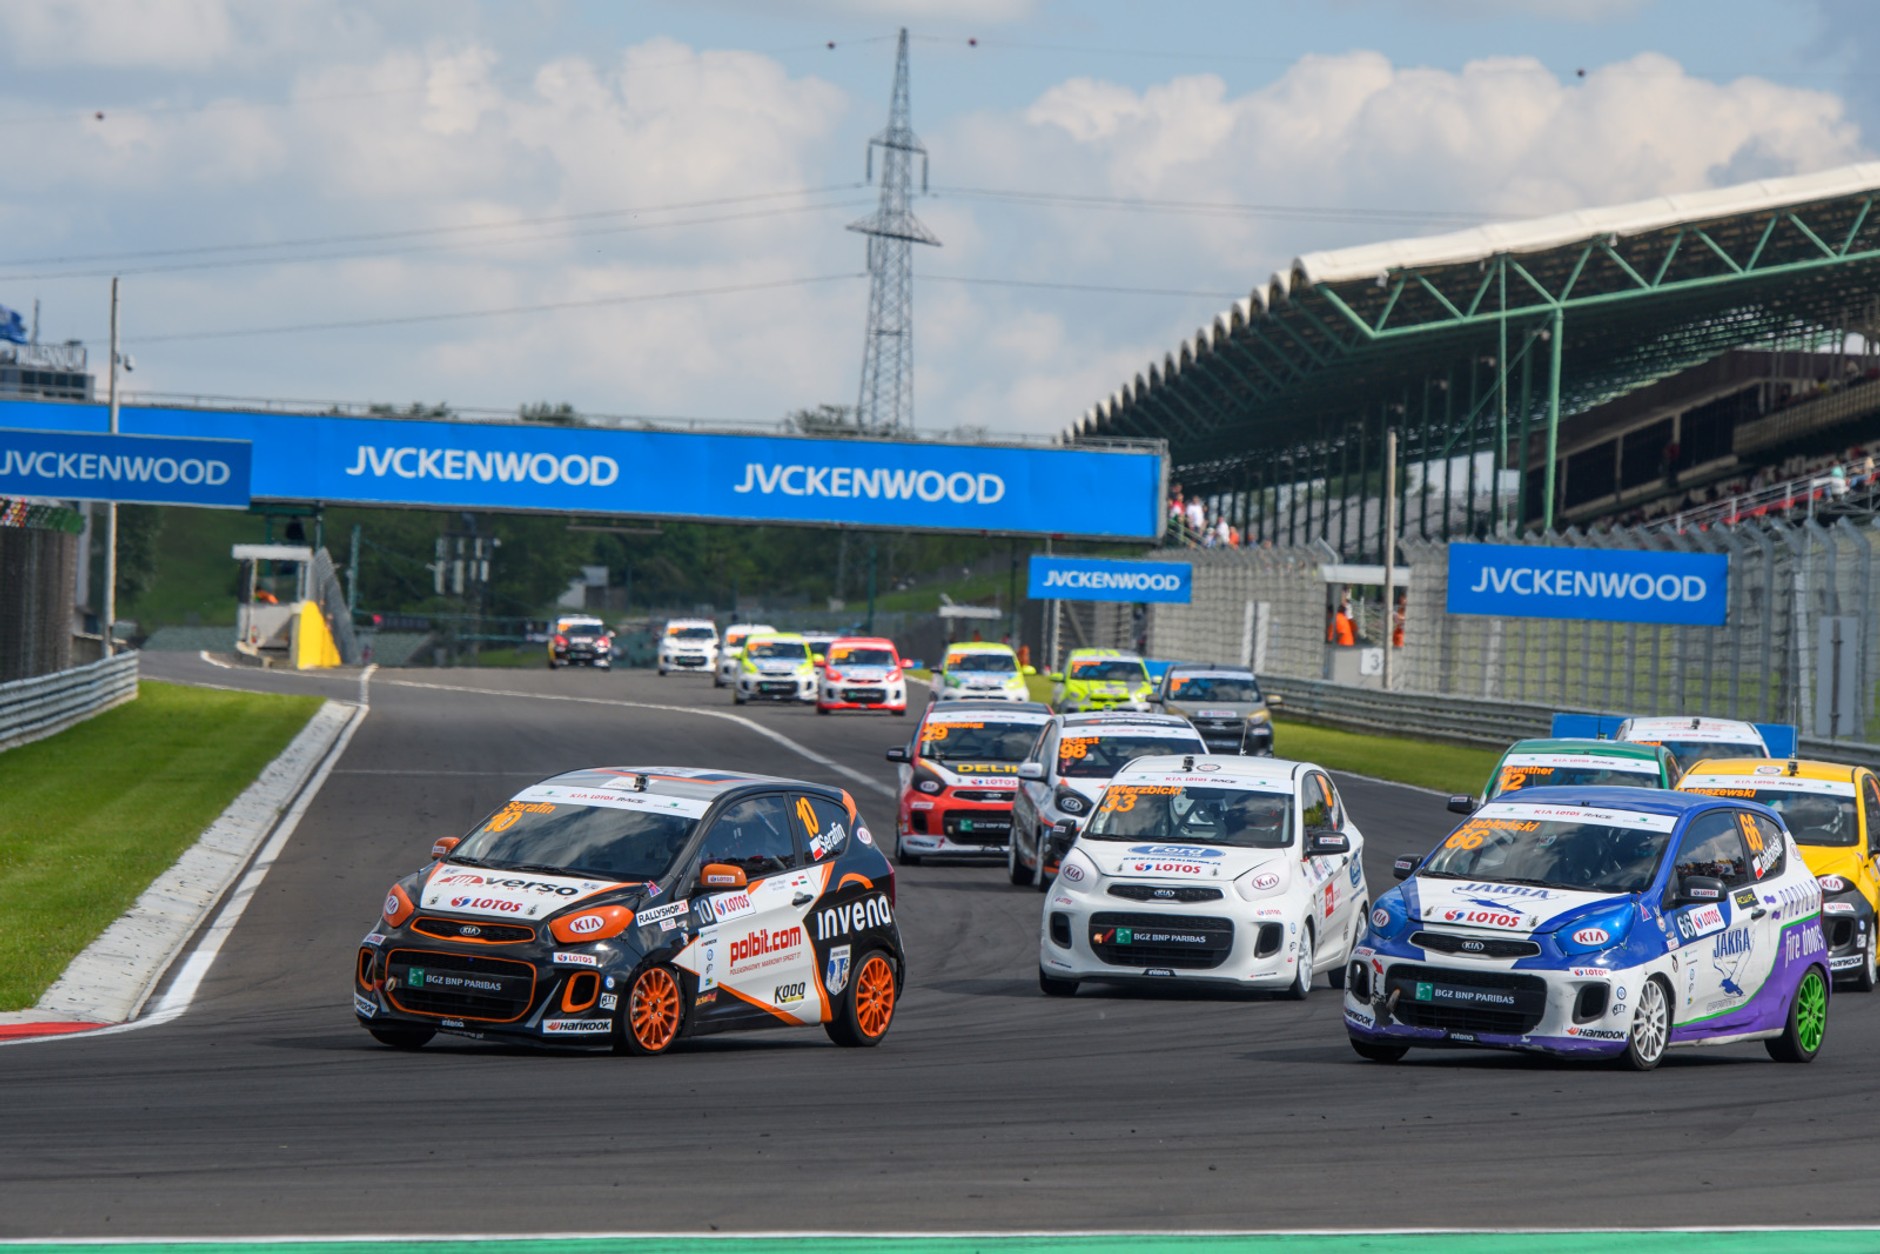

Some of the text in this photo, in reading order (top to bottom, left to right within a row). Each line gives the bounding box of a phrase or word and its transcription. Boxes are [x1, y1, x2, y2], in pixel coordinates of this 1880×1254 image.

[0, 450, 231, 486] JVCKENWOOD
[346, 445, 620, 487] JVCKENWOOD
[734, 463, 1006, 505] JVCKENWOOD
[1043, 569, 1182, 592] JVCKENWOOD
[1471, 566, 1708, 602] JVCKENWOOD
[1369, 652, 1381, 671] 3
[921, 726, 949, 742] 29
[1059, 743, 1088, 759] 98
[985, 778, 1017, 786] LOTOS
[1107, 784, 1184, 796] Wierzbicki
[504, 800, 557, 815] Serafin
[1099, 793, 1138, 813] 33
[484, 810, 524, 833] 10
[795, 796, 820, 838] 10
[1583, 812, 1614, 820] RACE
[816, 821, 847, 854] Serafin
[1443, 828, 1490, 850] 66
[1739, 813, 1764, 851] 66
[1063, 867, 1083, 881] KIA
[1154, 863, 1202, 874] LOTOS
[1457, 883, 1551, 899] JAKRA
[1821, 878, 1841, 889] KIA
[385, 897, 398, 913] KIA
[470, 898, 523, 913] LOTOS
[693, 898, 715, 924] 10
[723, 893, 751, 914] LOTOS
[638, 904, 680, 924] RALLYSHOP
[1373, 910, 1389, 926] KIA
[1466, 911, 1521, 928] LOTOS
[1700, 908, 1722, 927] LOTOS
[573, 916, 601, 932] KIA
[1676, 914, 1697, 940] 66
[1464, 941, 1481, 950] KIA
[1578, 931, 1605, 943] KIA
[1713, 927, 1751, 958] JAKRA
[729, 926, 802, 968] polbit.com
[1784, 930, 1800, 969] fire
[568, 954, 593, 964] LOTOS
[445, 976, 464, 986] BNP
[464, 979, 502, 991] PARIBAS
[1455, 990, 1475, 1001] BNP
[1474, 992, 1515, 1005] PARIBAS
